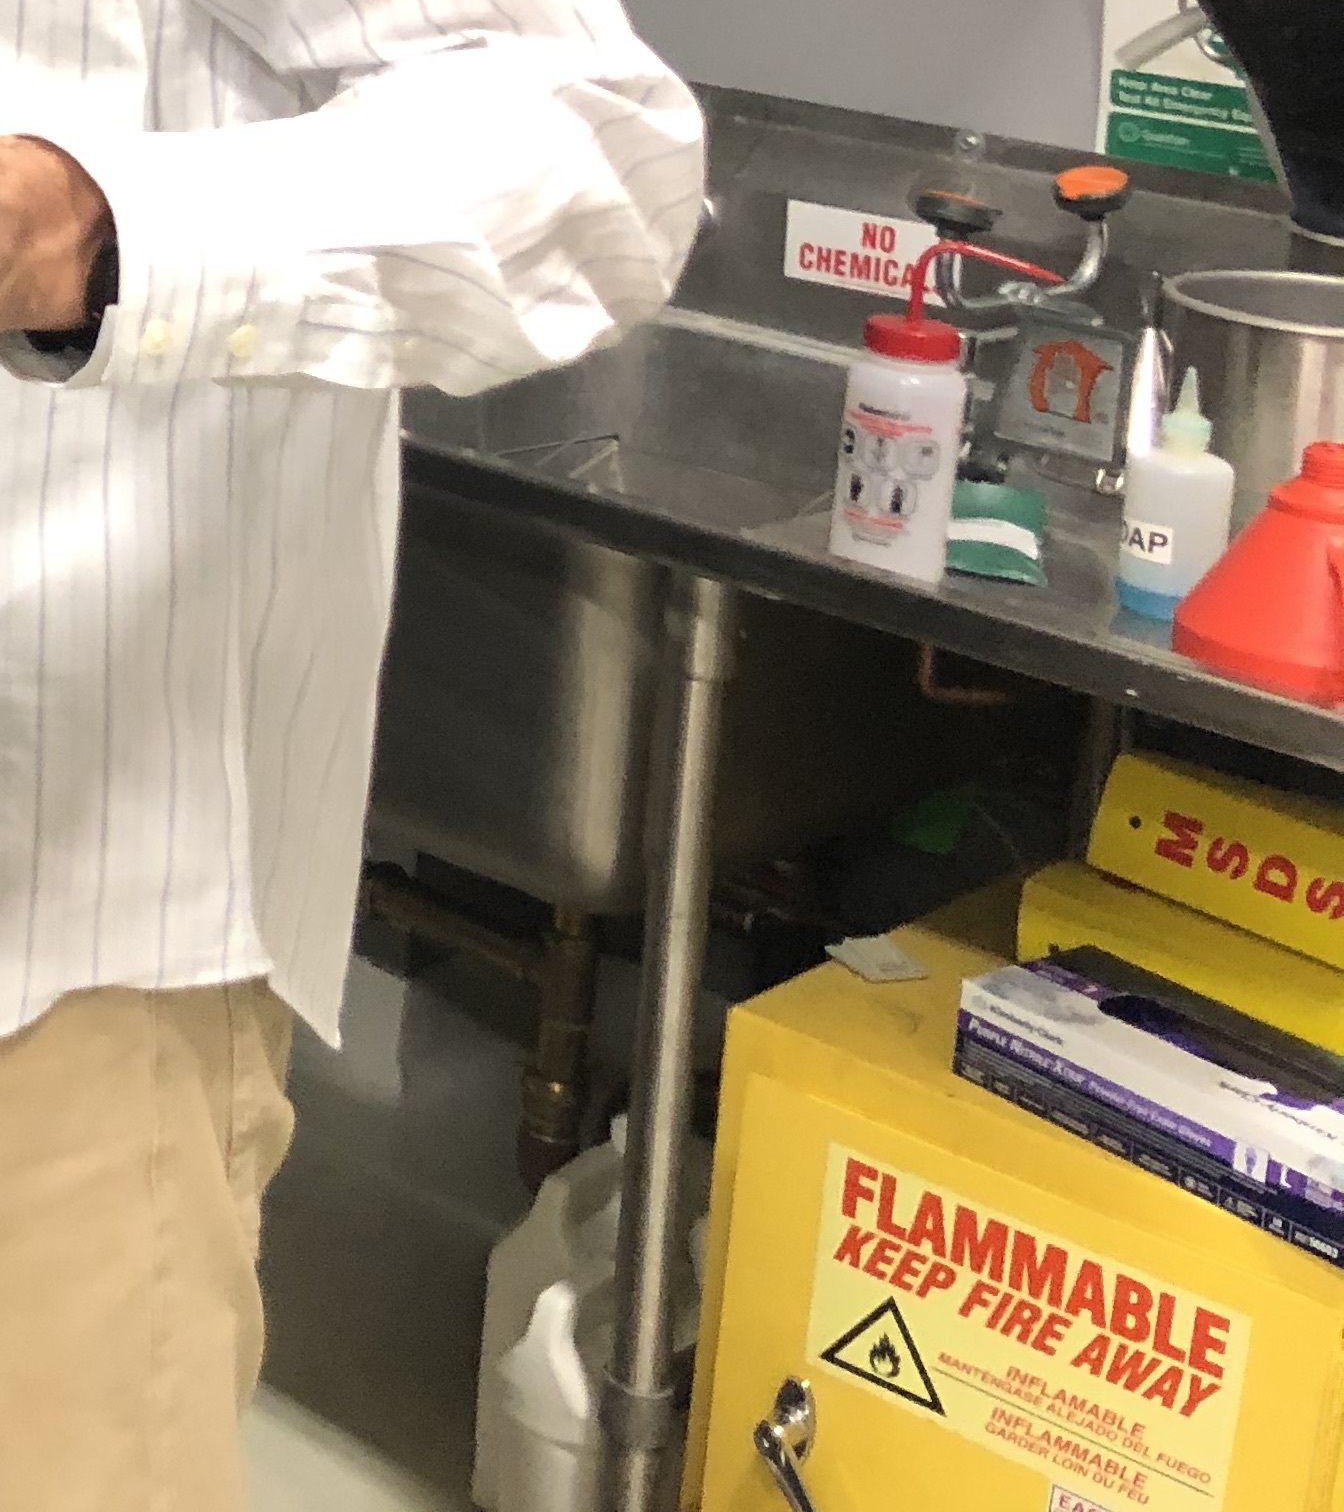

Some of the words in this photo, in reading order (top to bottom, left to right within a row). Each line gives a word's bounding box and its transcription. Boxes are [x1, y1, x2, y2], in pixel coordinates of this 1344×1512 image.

[799, 242, 936, 292] CHEMICA
[862, 222, 896, 253] NO
[1122, 521, 1169, 554] AP
[1155, 809, 1344, 920] MSDS
[841, 1157, 1231, 1380] FLAMMABLE
[833, 1224, 957, 1300] KEEP
[958, 1279, 1073, 1357] FIRE
[1070, 1333, 1222, 1419] AWAY
[1005, 1365, 1146, 1437] INFLAMABLE
[984, 1423, 1050, 1463] GARDER
[1052, 1453, 1089, 1478] LOIN
[1092, 1473, 1116, 1489] DU
[1118, 1484, 1150, 1506] FEU
[991, 1407, 1149, 1488] INFLAMMABLE
[1046, 1404, 1118, 1442] ALEJADO
[1121, 1437, 1152, 1458] DEL
[1157, 1451, 1212, 1485] FUEGO
